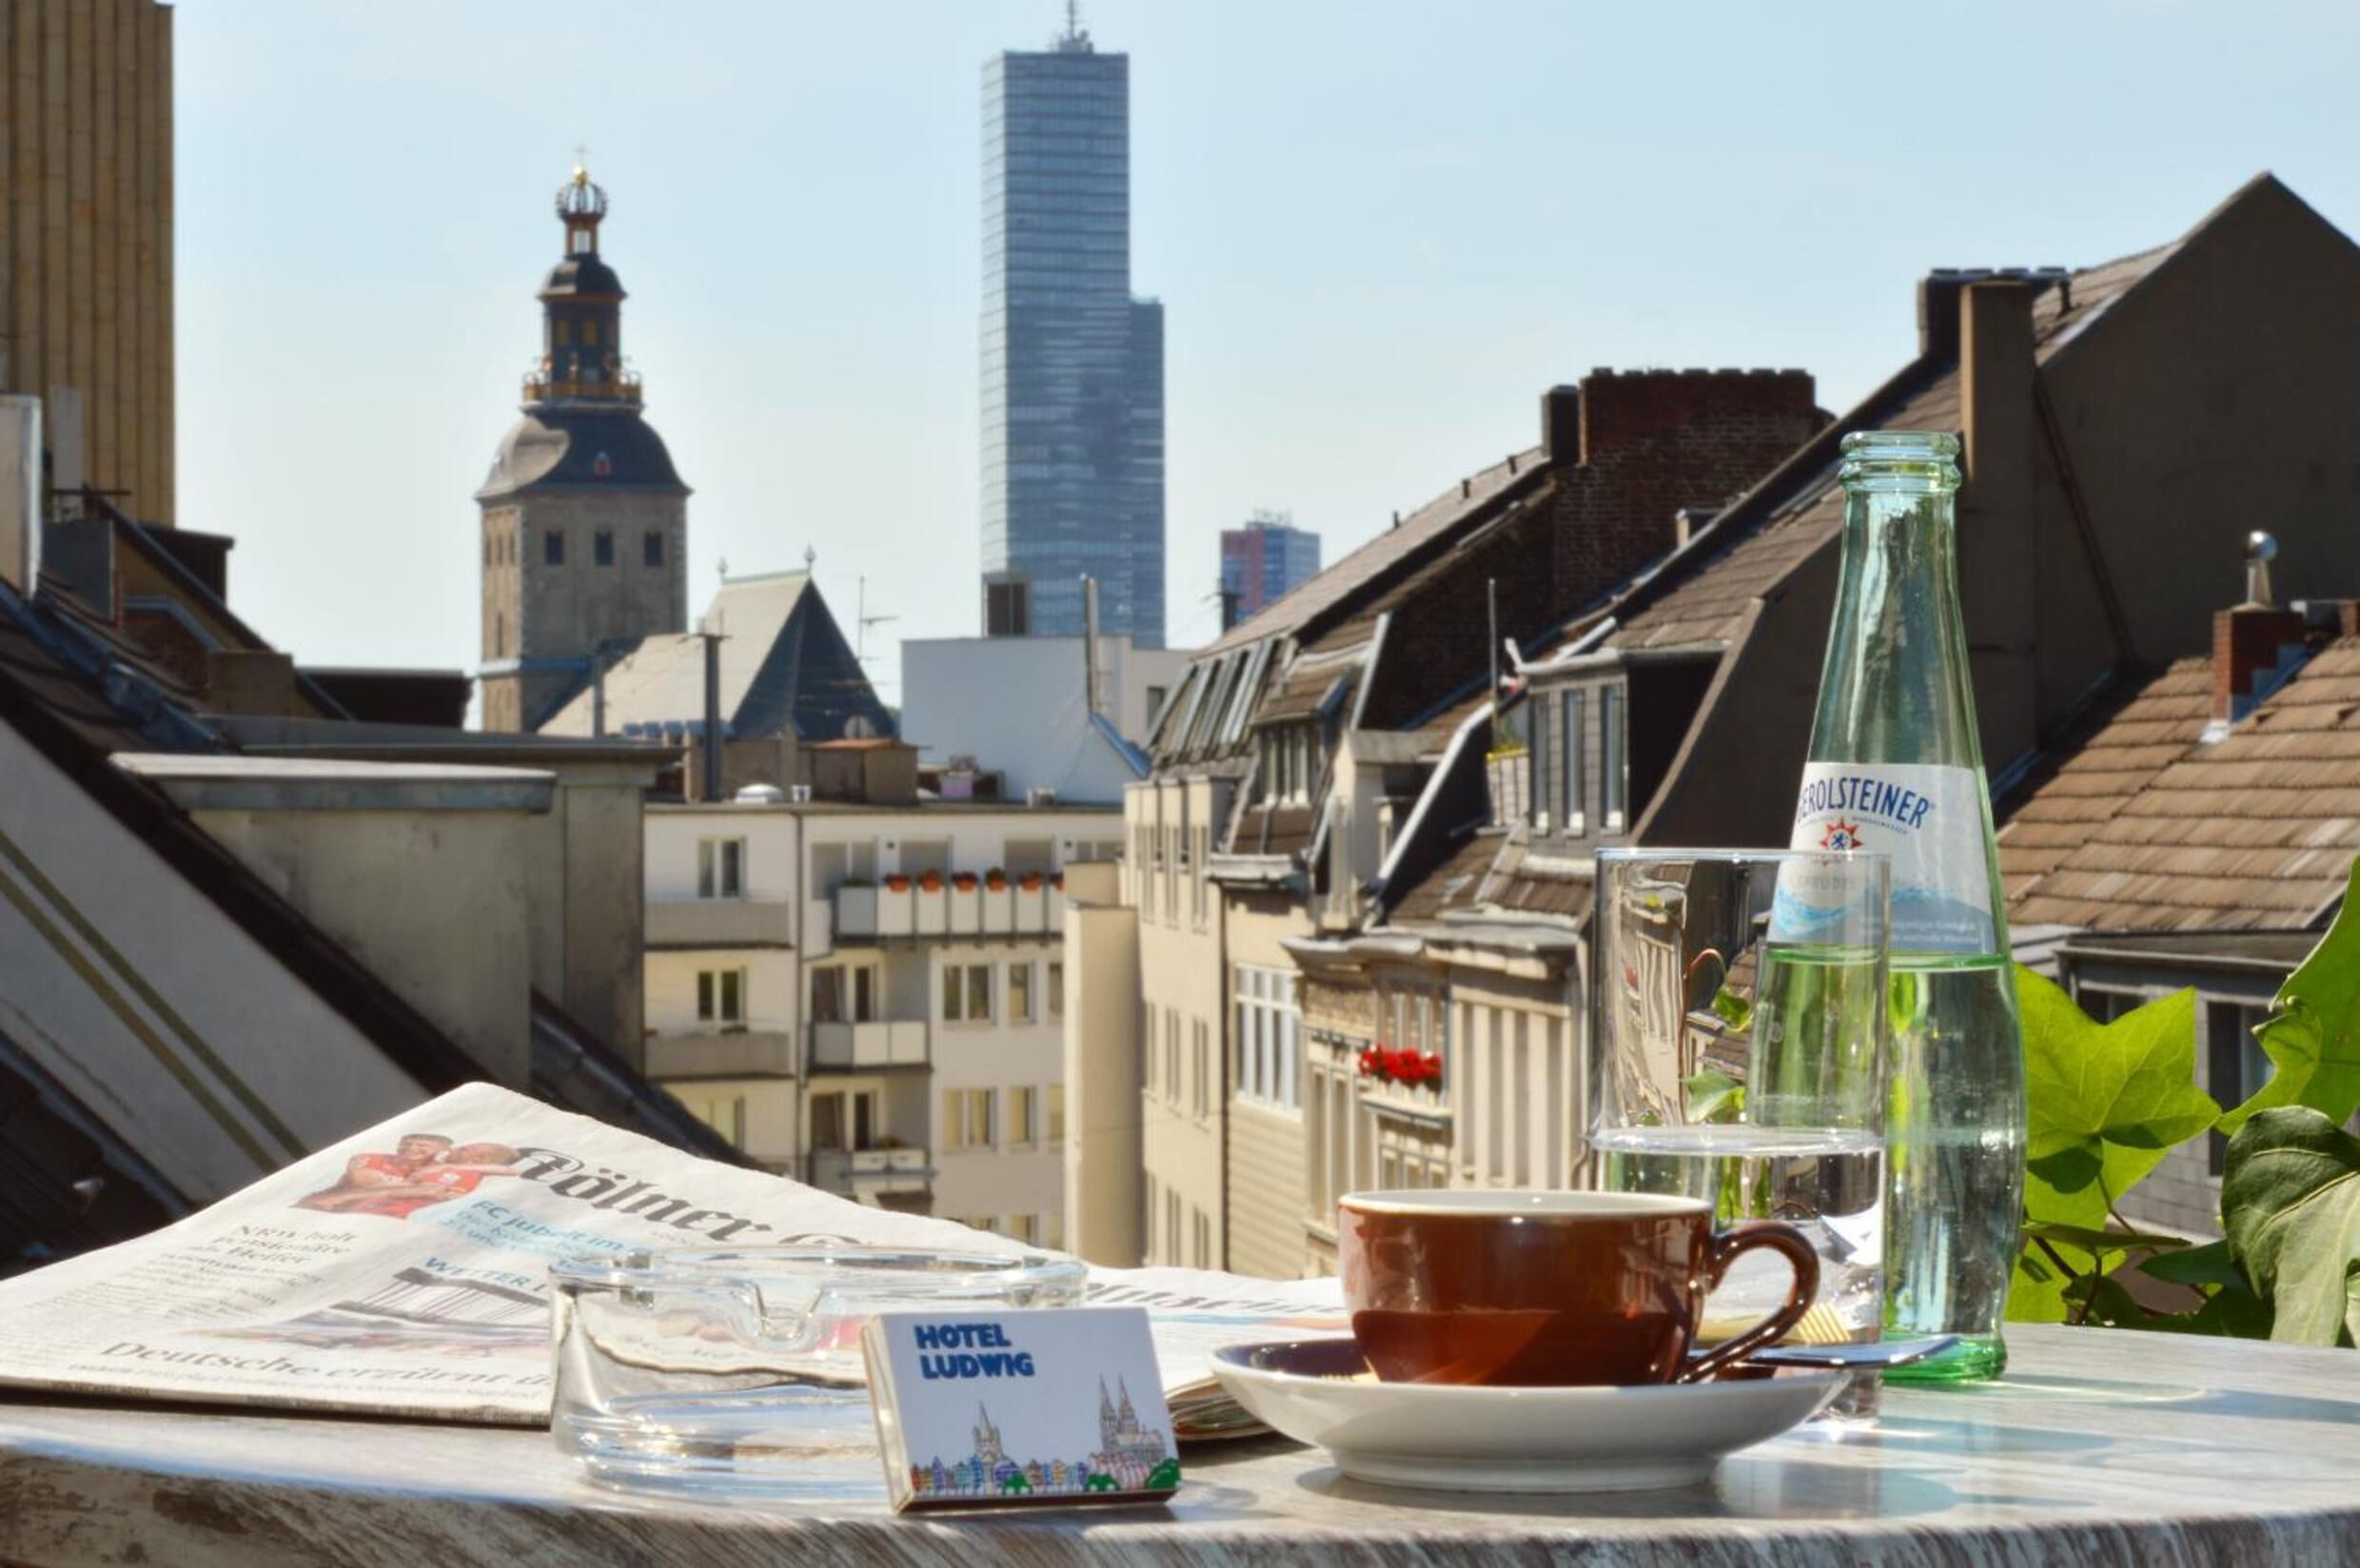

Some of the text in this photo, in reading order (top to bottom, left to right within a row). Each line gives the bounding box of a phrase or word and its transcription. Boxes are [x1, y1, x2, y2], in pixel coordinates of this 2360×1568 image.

[472, 1199, 510, 1220] FC
[515, 1147, 772, 1243] Kölner
[914, 1323, 1013, 1349] HOTEL
[101, 1341, 318, 1377] Deutsche
[919, 1351, 1035, 1380] LUDWIG
